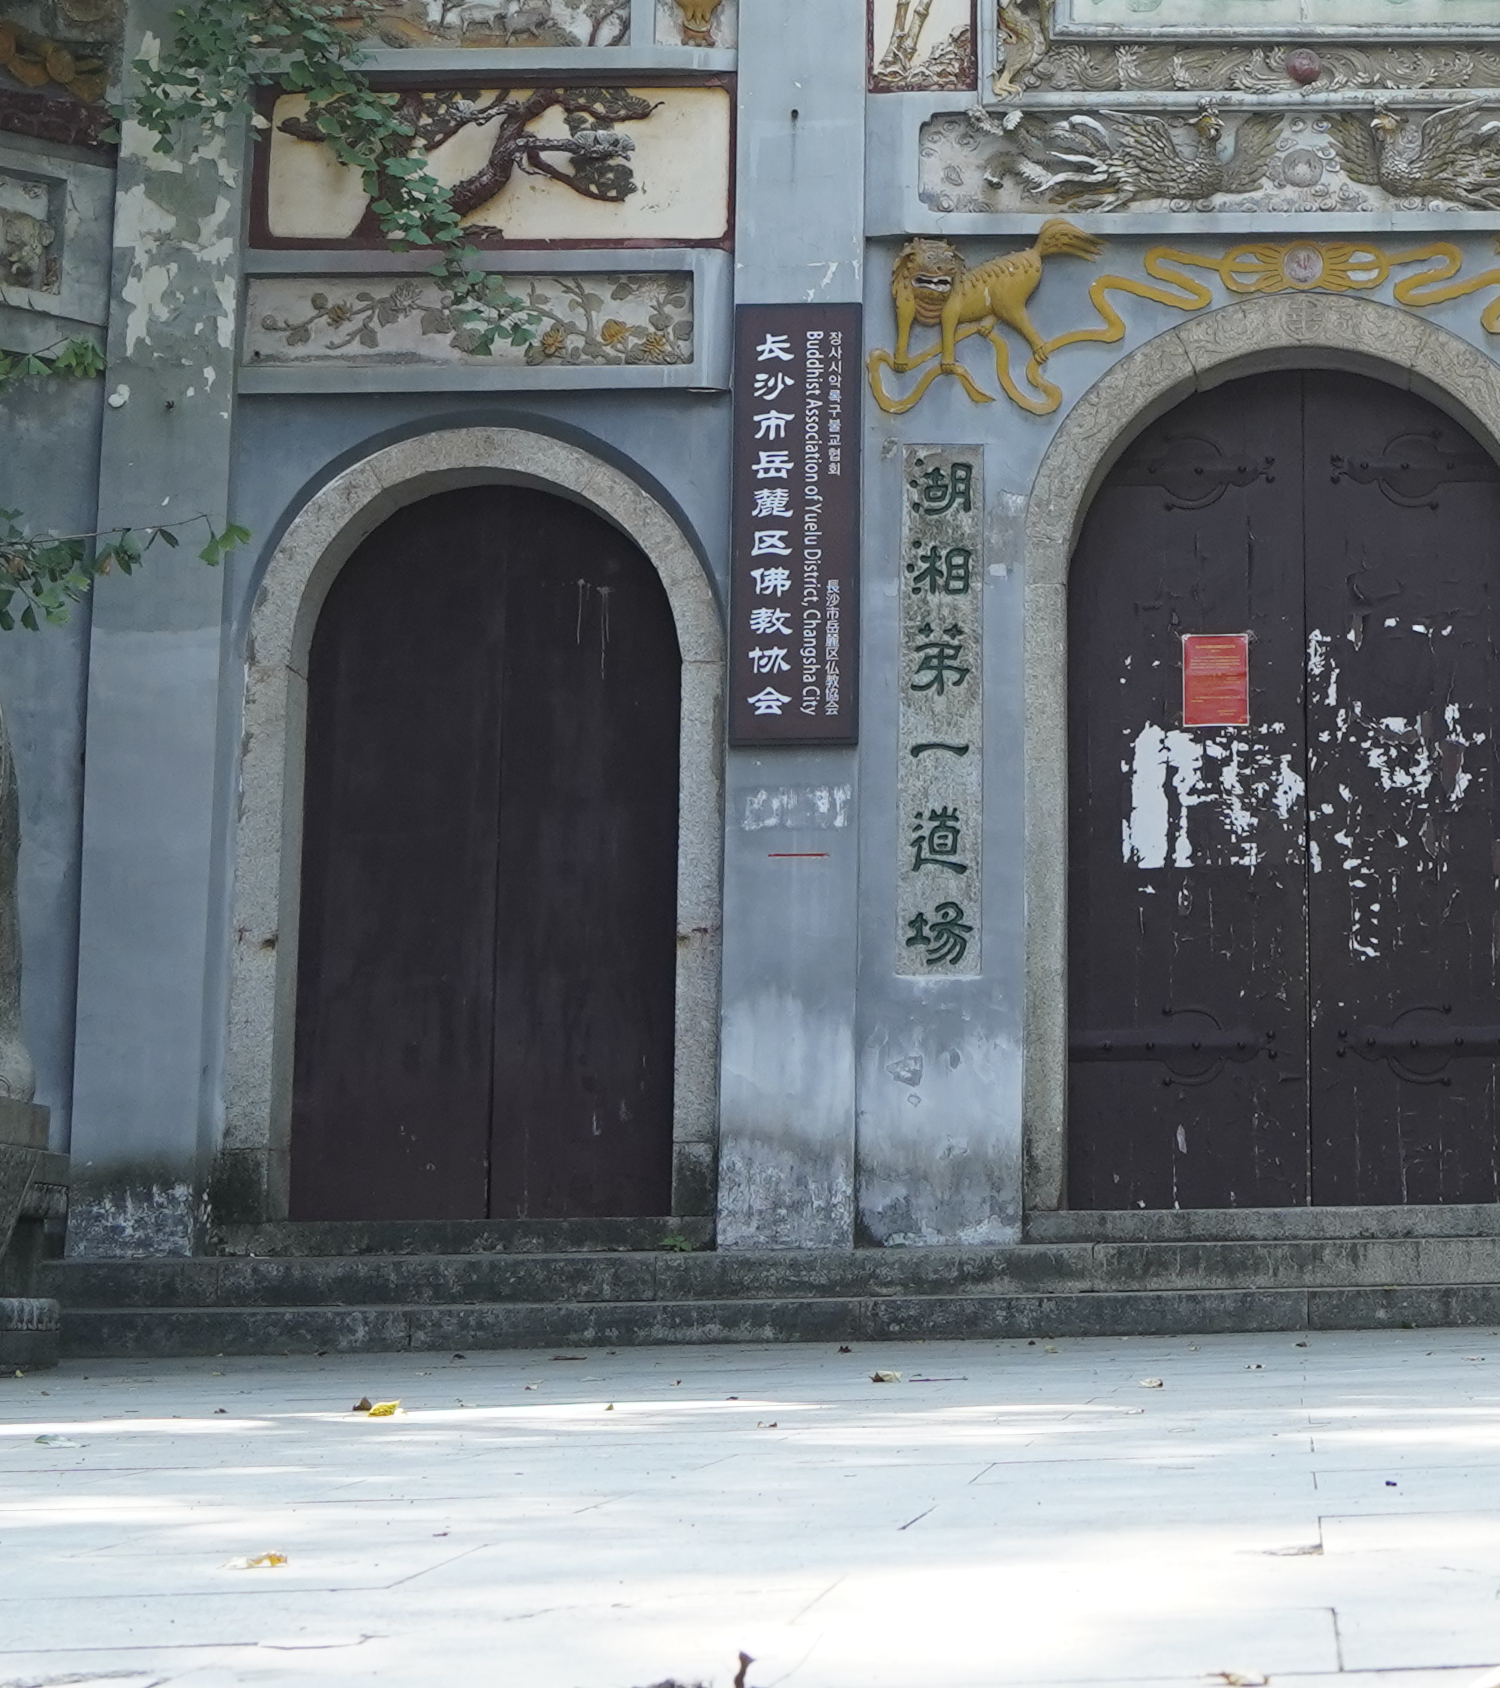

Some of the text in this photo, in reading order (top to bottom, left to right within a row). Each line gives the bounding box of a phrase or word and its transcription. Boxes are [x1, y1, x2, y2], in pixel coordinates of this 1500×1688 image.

[747, 333, 795, 716] 长沙市岳麓区佛教协会
[800, 331, 824, 716] Buddhist Association of Yuelu District, Changsha City
